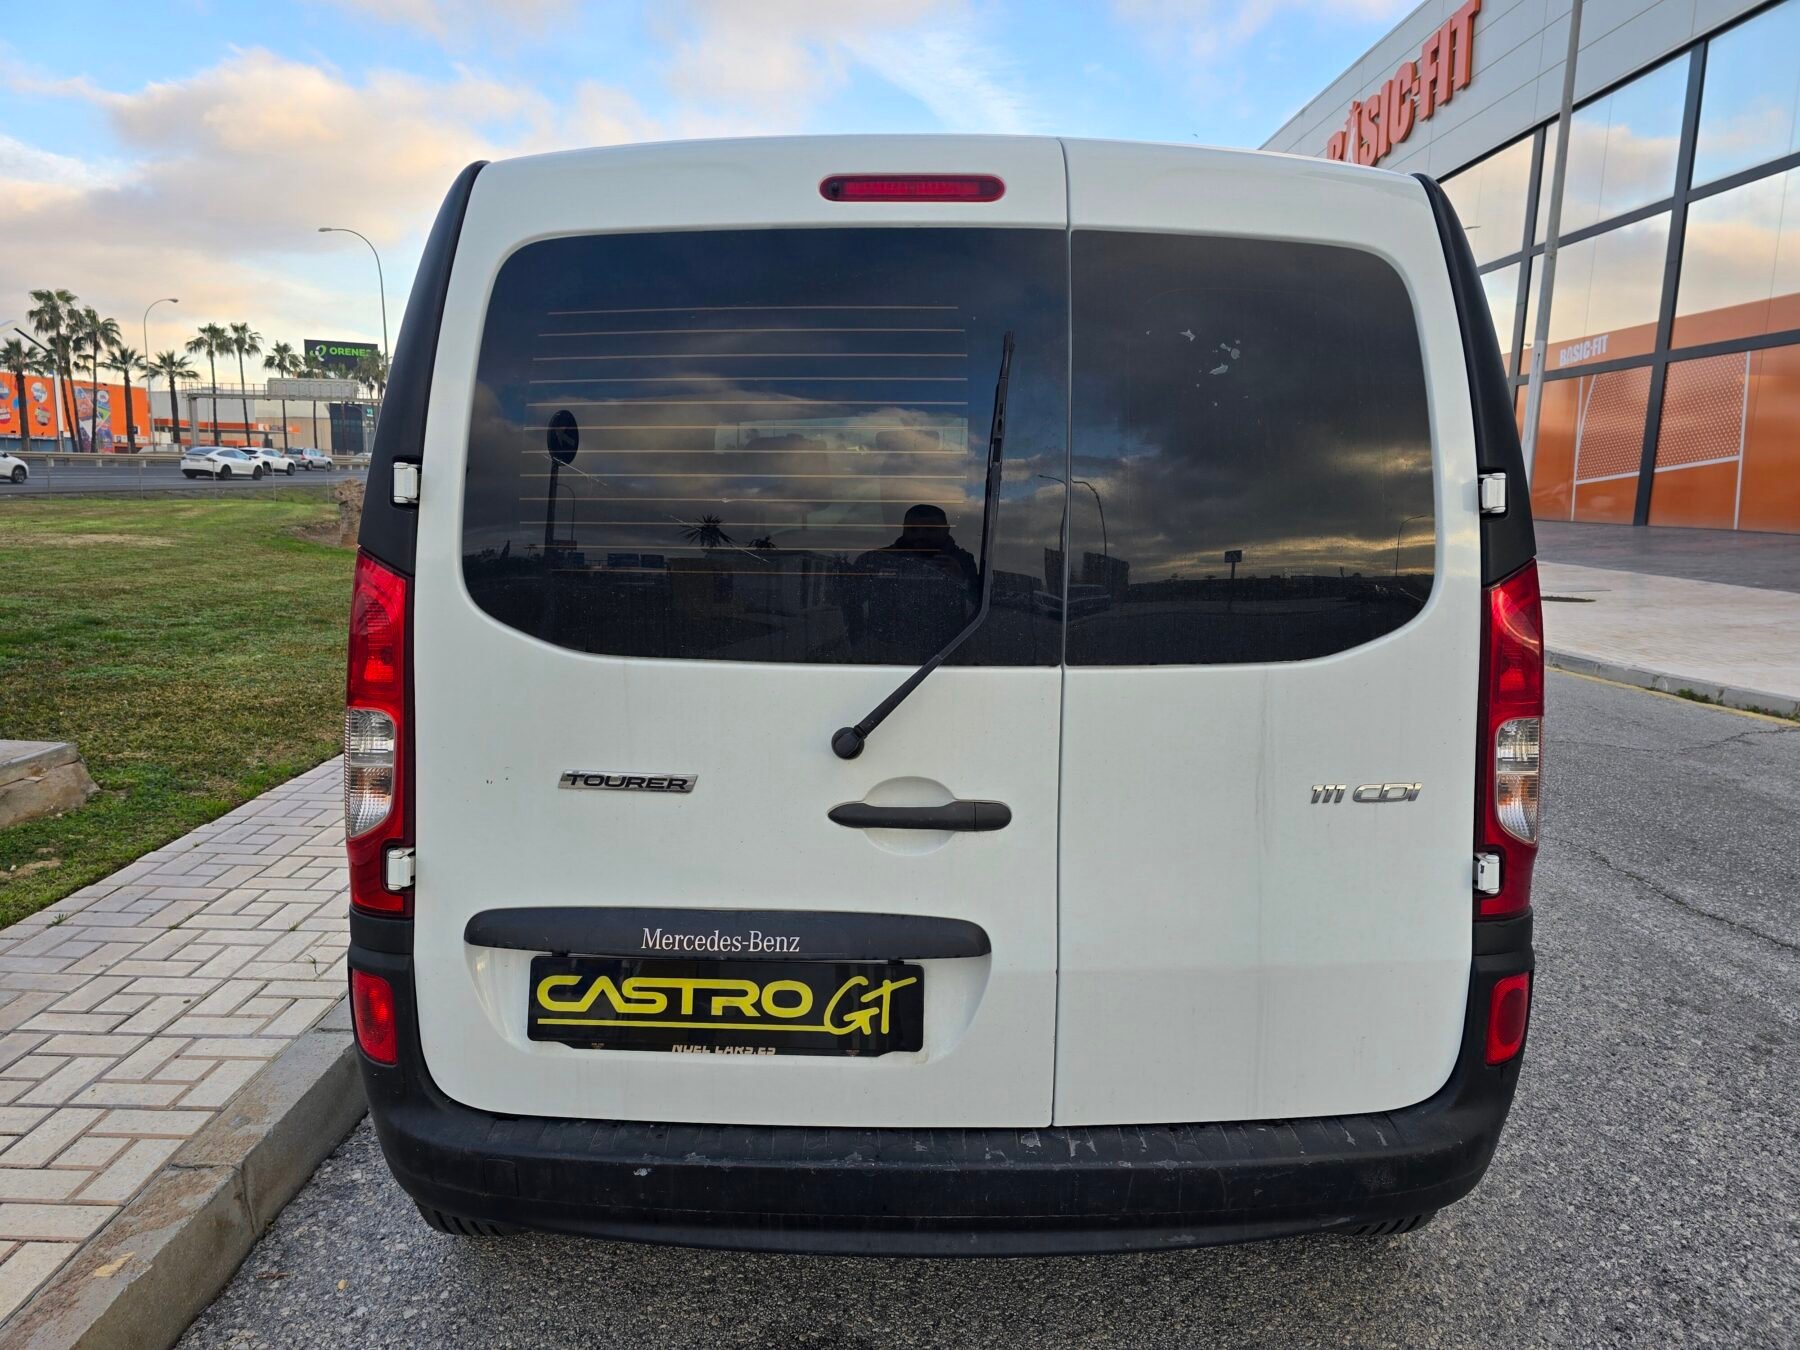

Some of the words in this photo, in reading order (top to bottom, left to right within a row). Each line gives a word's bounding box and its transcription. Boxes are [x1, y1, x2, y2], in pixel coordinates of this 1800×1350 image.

[329, 346, 372, 357] ORENE
[566, 773, 689, 790] TOURER
[1311, 784, 1347, 804] 111
[640, 927, 801, 953] Mercedes-Benz
[536, 974, 813, 1018] CASTRO
[823, 975, 917, 1035] GT
